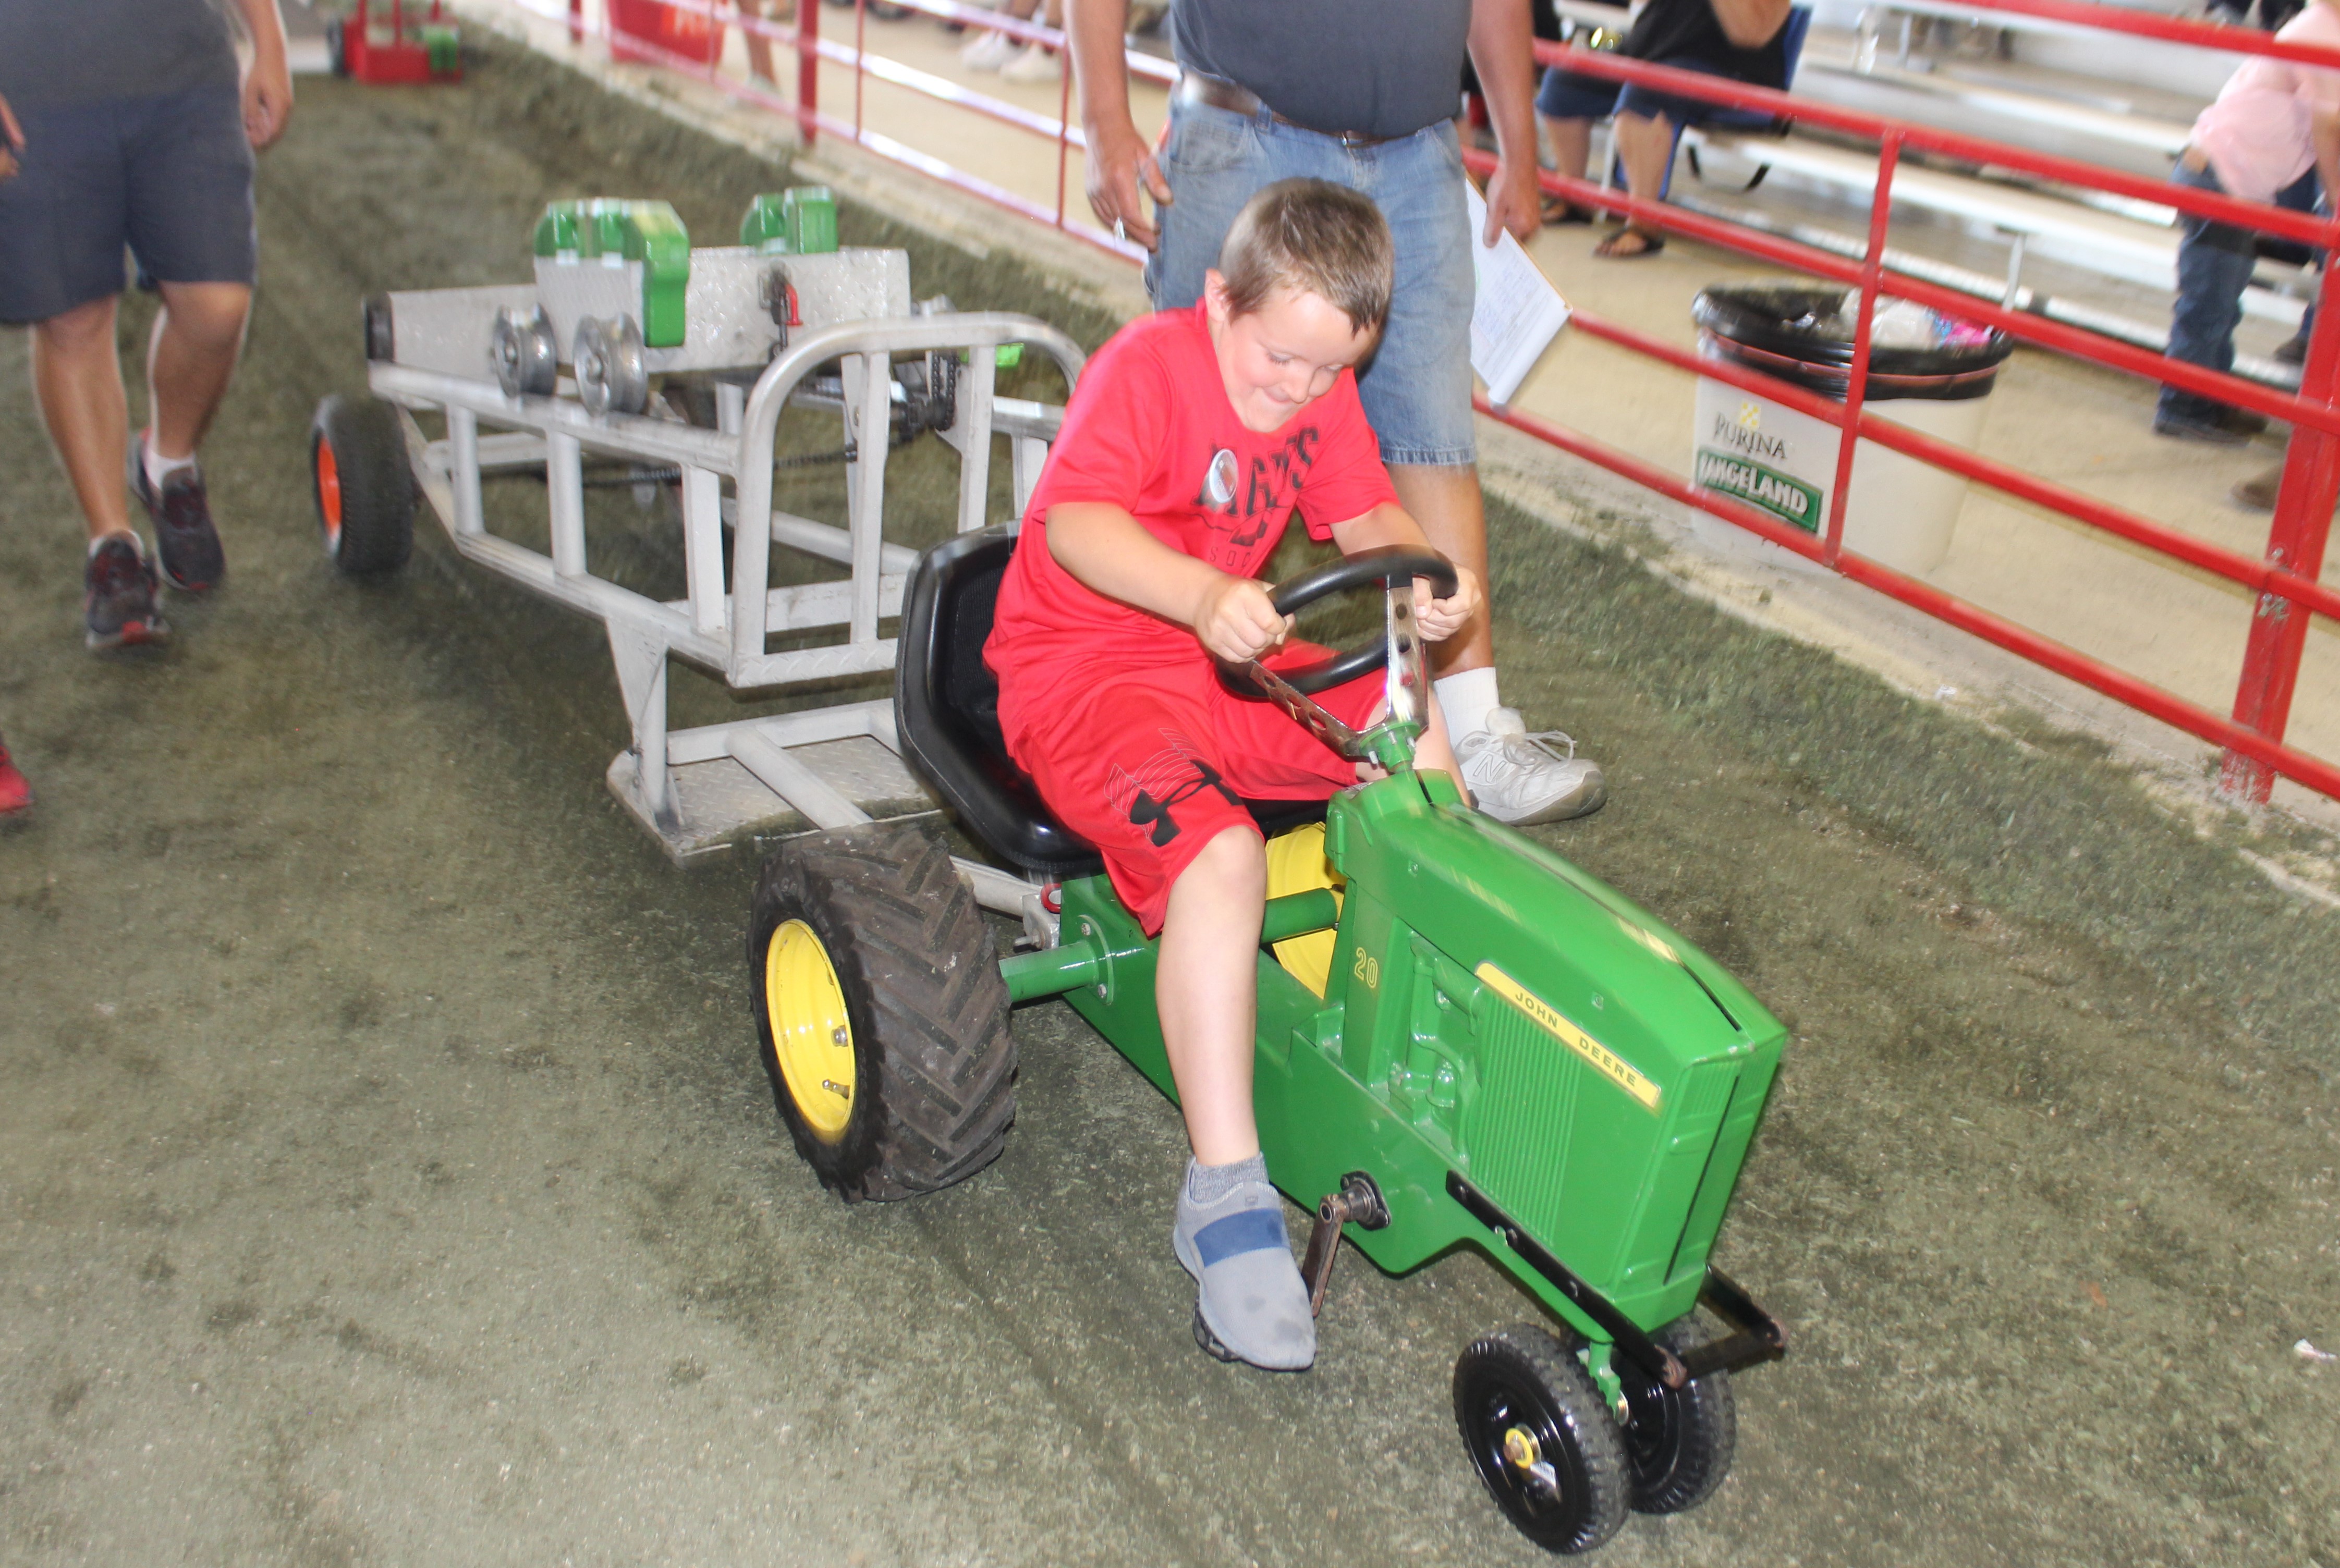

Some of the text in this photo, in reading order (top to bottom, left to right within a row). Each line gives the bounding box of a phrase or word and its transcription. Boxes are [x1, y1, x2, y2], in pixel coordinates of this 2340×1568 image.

[1713, 412, 1788, 460] PURINA
[1354, 947, 1378, 988] 20
[1515, 992, 1636, 1087] JOHN DEERE
